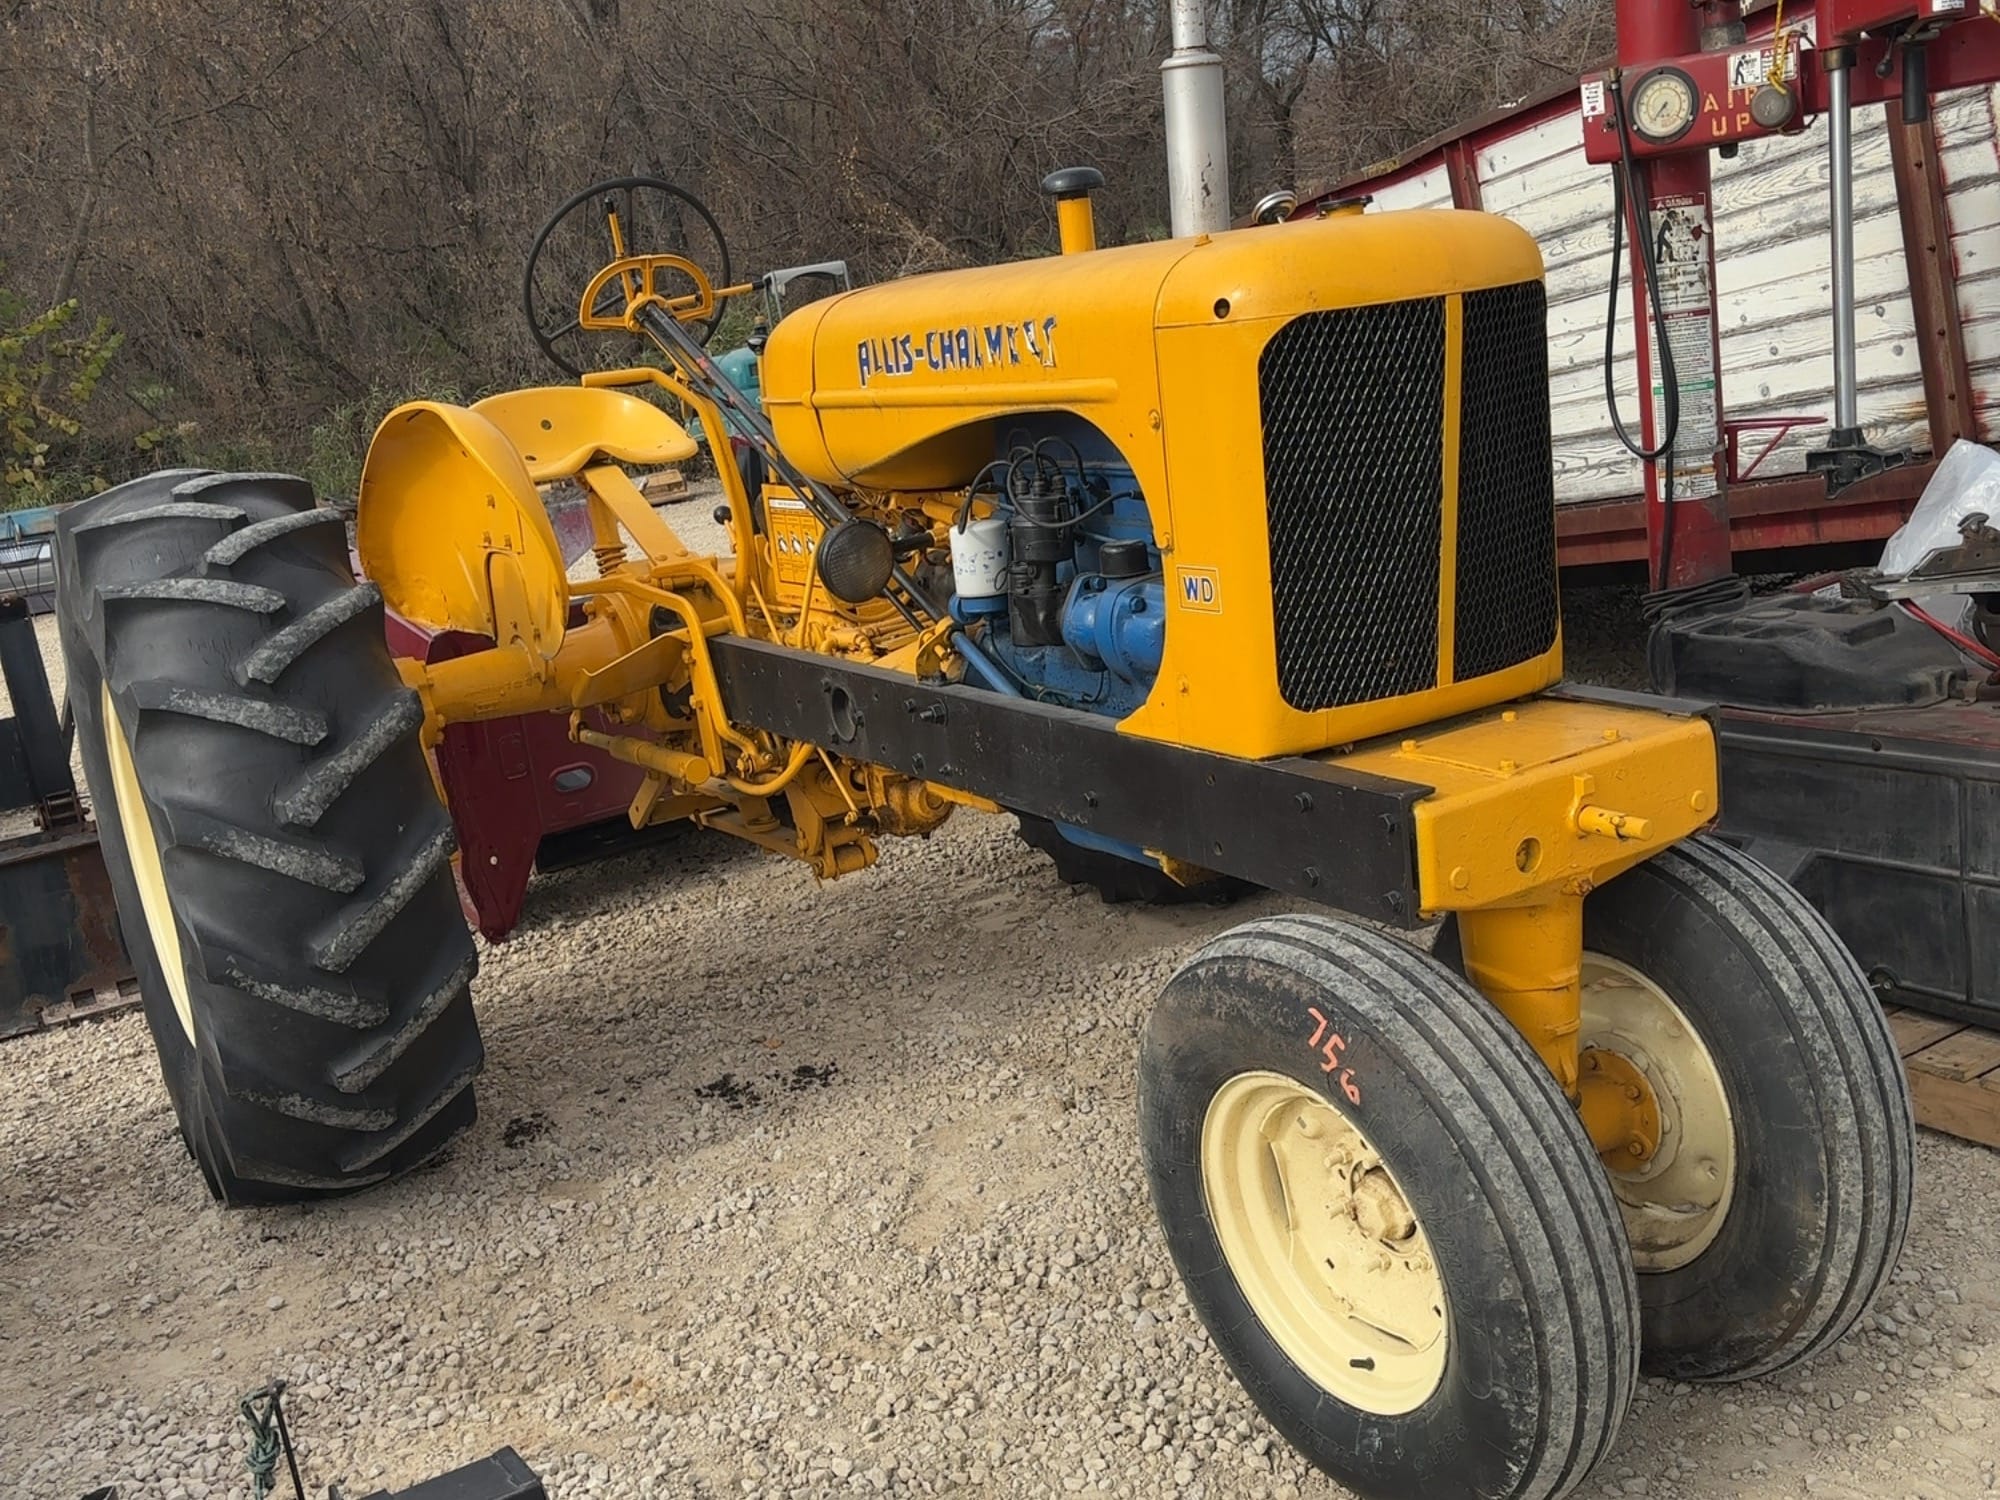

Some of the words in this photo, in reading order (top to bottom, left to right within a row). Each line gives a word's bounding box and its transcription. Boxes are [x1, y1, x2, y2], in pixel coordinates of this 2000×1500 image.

[1711, 113, 1751, 137] UP
[1183, 575, 1214, 603] WD
[1307, 1006, 1361, 1106] 756
